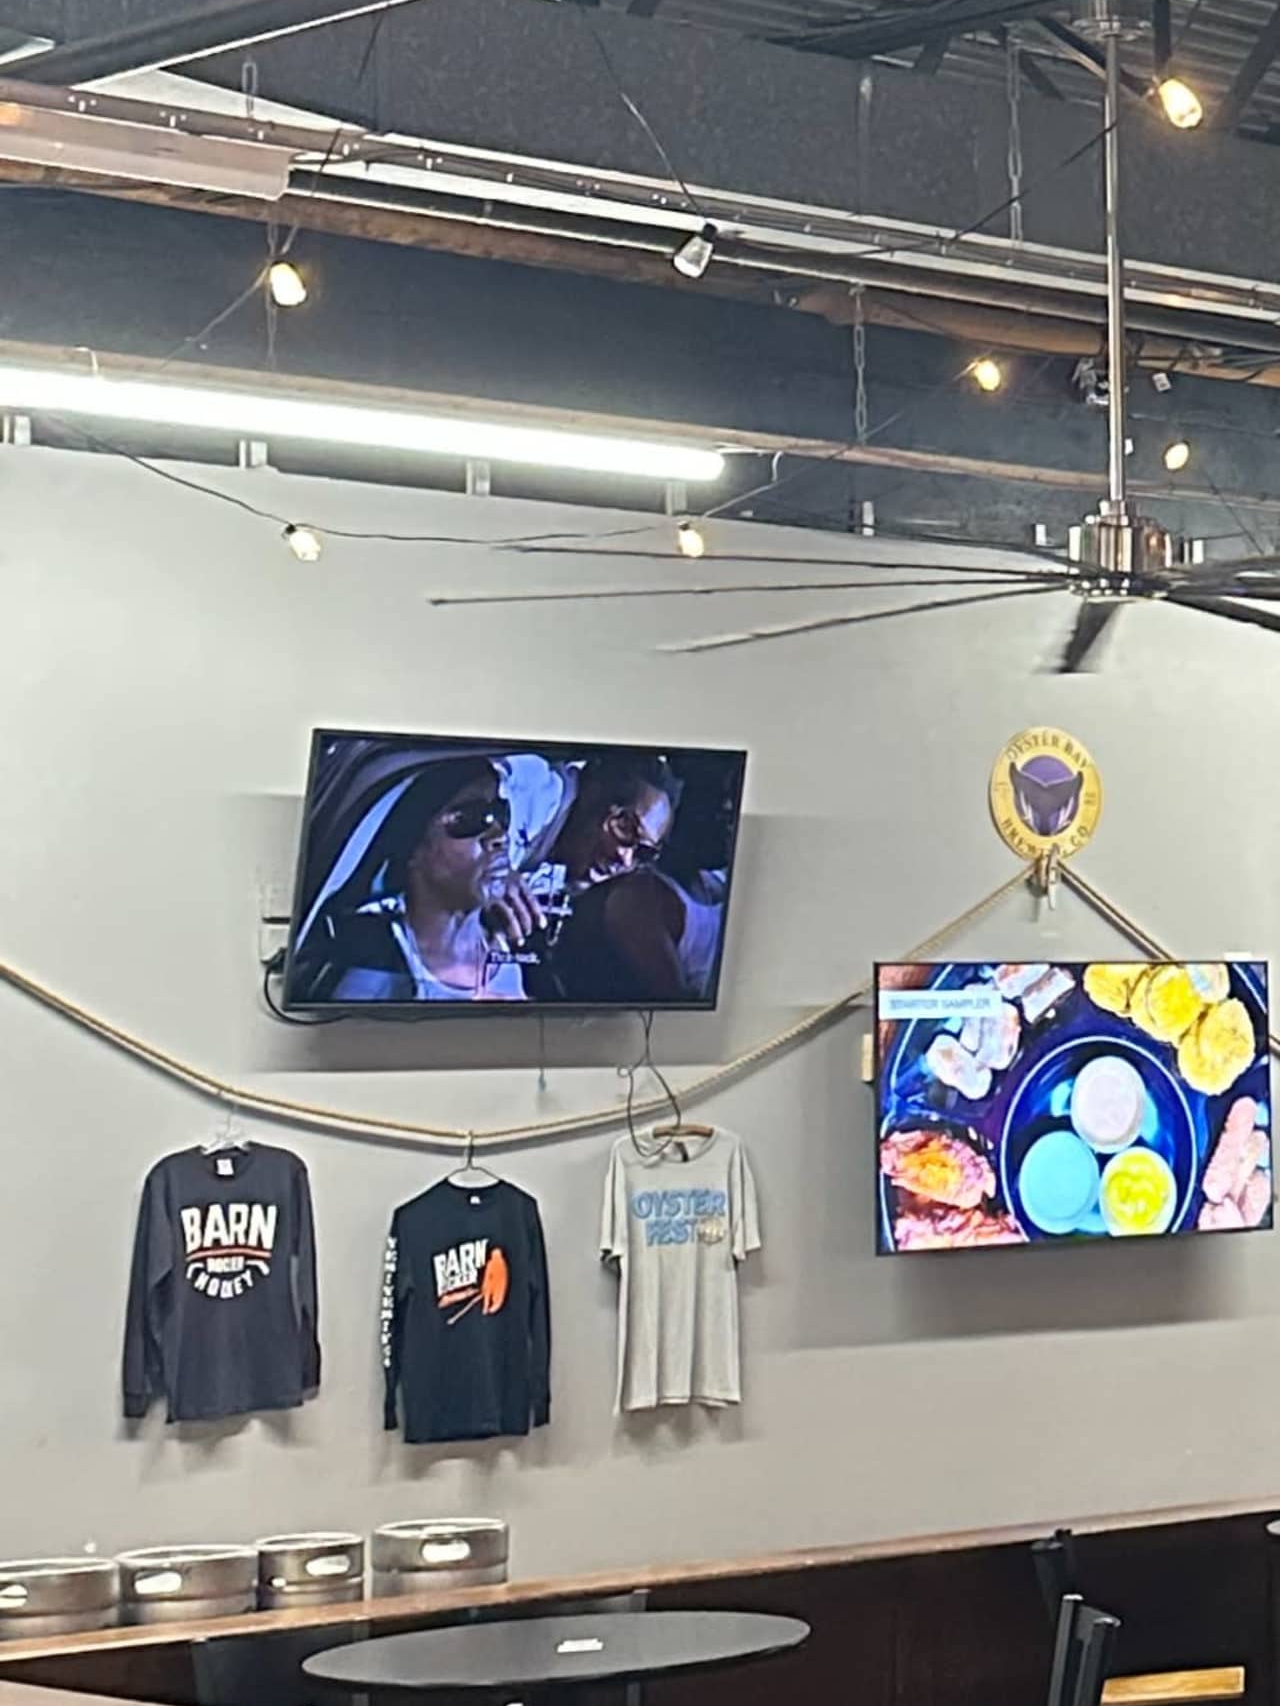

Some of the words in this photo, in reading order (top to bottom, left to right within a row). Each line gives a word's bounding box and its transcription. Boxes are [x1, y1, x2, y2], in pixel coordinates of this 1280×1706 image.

[1007, 730, 1059, 760] OYSTER
[633, 1189, 726, 1219] OYSTER
[180, 1203, 277, 1254] BARN
[433, 1238, 489, 1285] BARN
